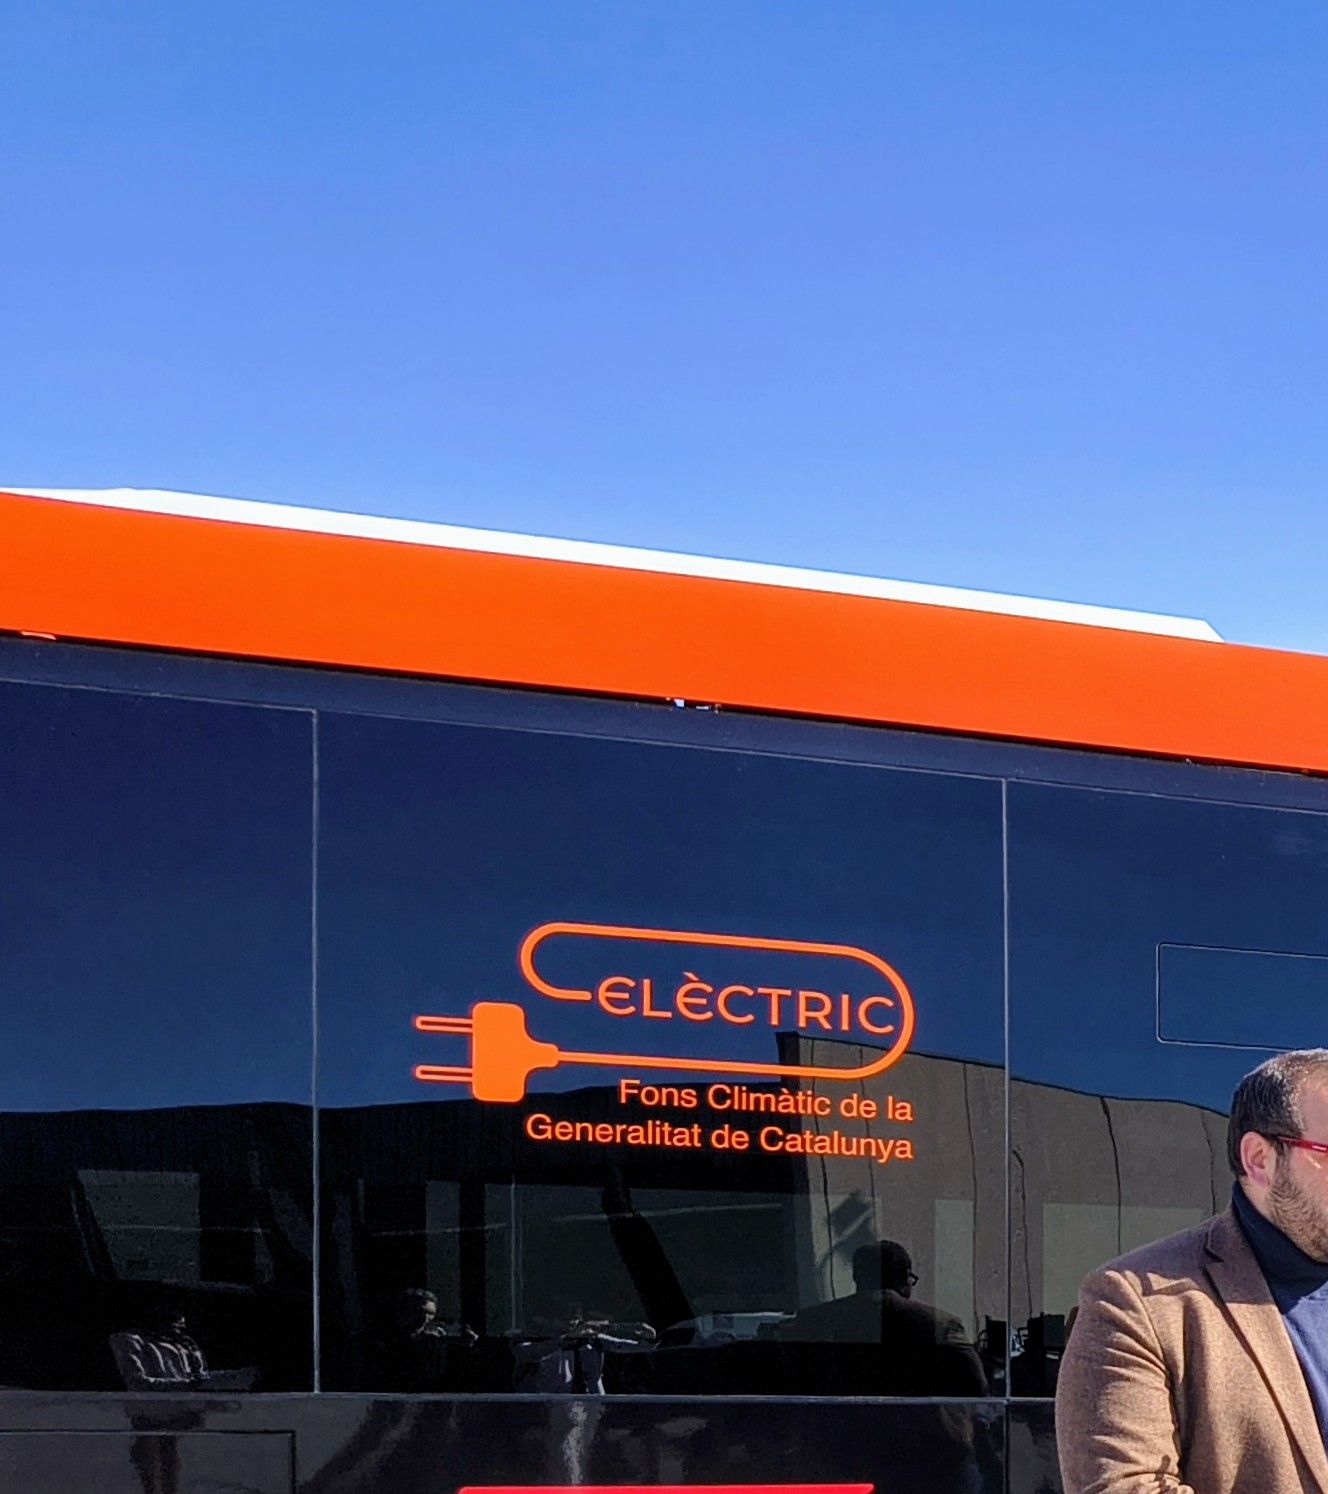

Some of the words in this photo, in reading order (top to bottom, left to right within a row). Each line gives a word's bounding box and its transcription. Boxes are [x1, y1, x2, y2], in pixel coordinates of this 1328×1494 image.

[599, 971, 896, 1035] ELÈCTRIC
[619, 1079, 697, 1108] Fons
[707, 1082, 831, 1117] Climàtic
[840, 1091, 877, 1120] de
[887, 1095, 913, 1122] la
[526, 1114, 701, 1148] Generalitat
[712, 1124, 749, 1151] de
[759, 1126, 913, 1164] Catalunya
